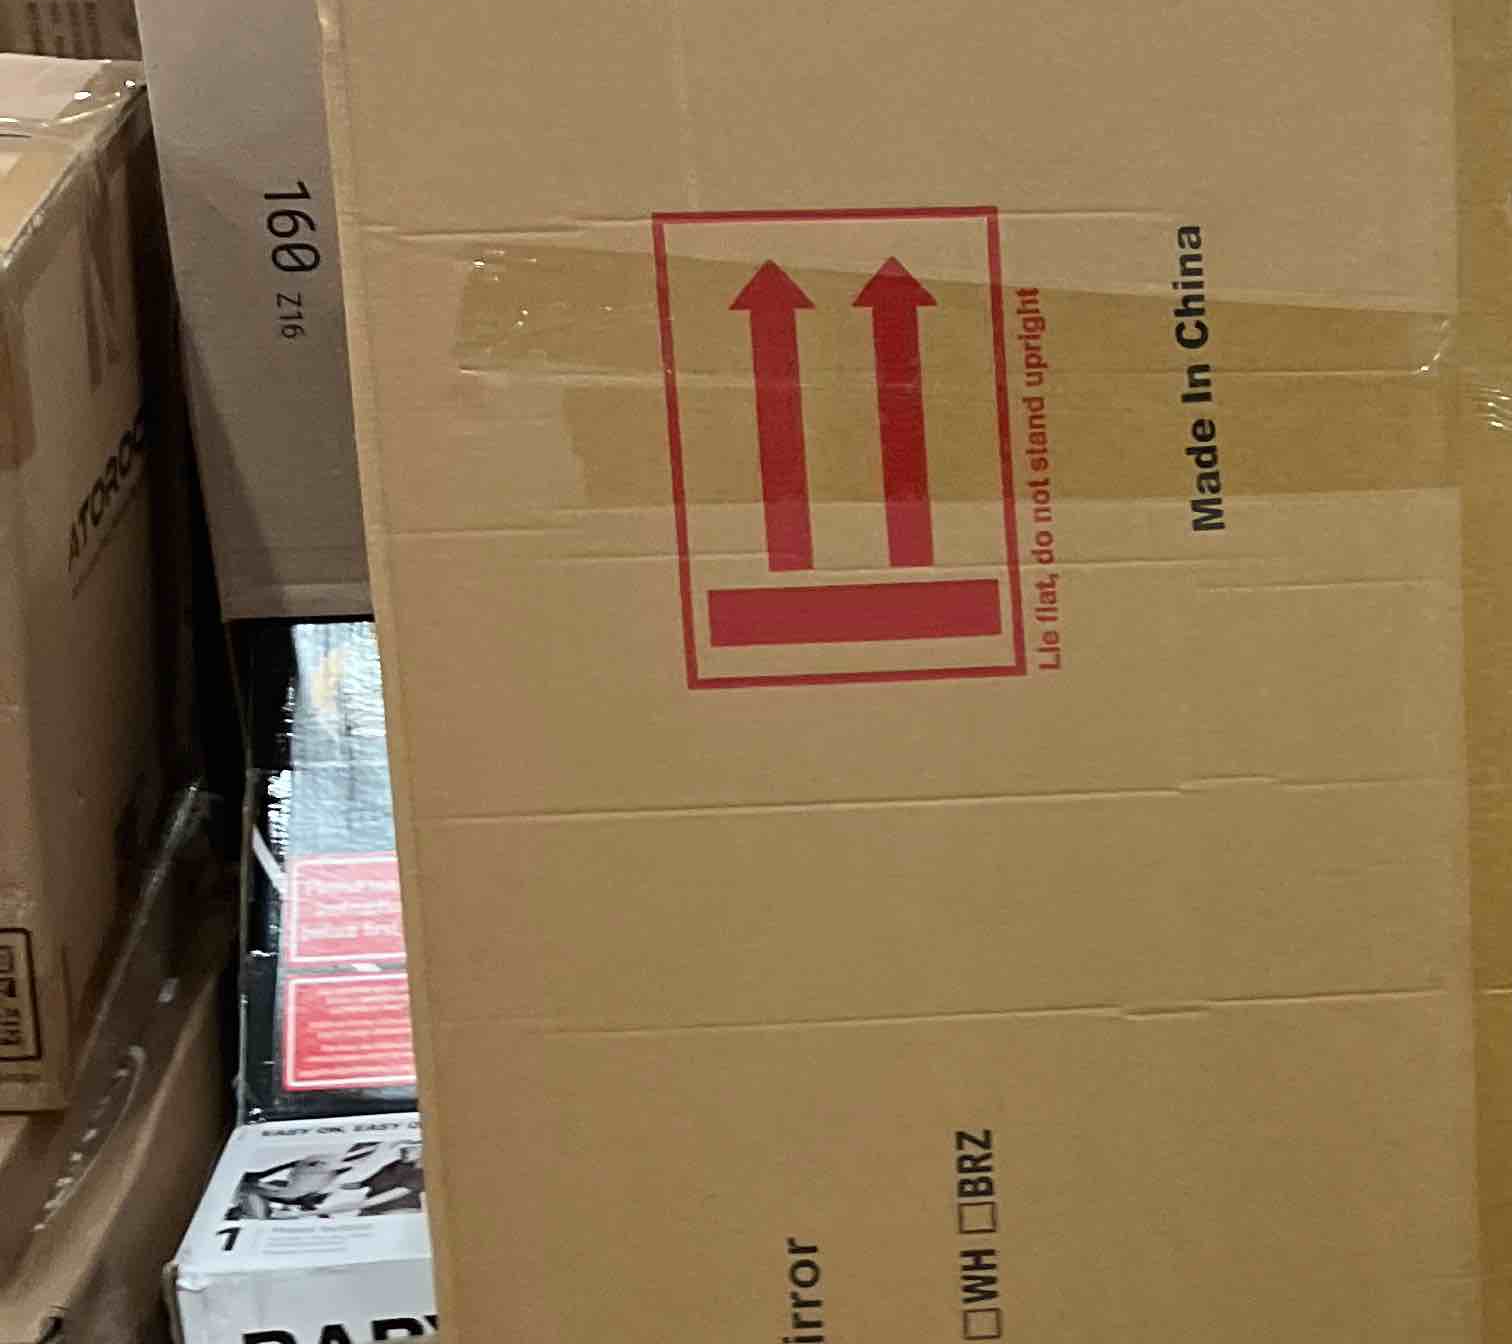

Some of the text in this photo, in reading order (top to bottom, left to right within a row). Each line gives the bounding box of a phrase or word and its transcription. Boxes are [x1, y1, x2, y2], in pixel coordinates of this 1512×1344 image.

[264, 181, 320, 272] 160
[1172, 226, 1225, 530] Made In China
[1015, 288, 1059, 670] Lie flat, do not stand upright
[956, 1130, 994, 1197] BRZ
[216, 1227, 241, 1251] 1
[960, 1249, 998, 1303] WH
